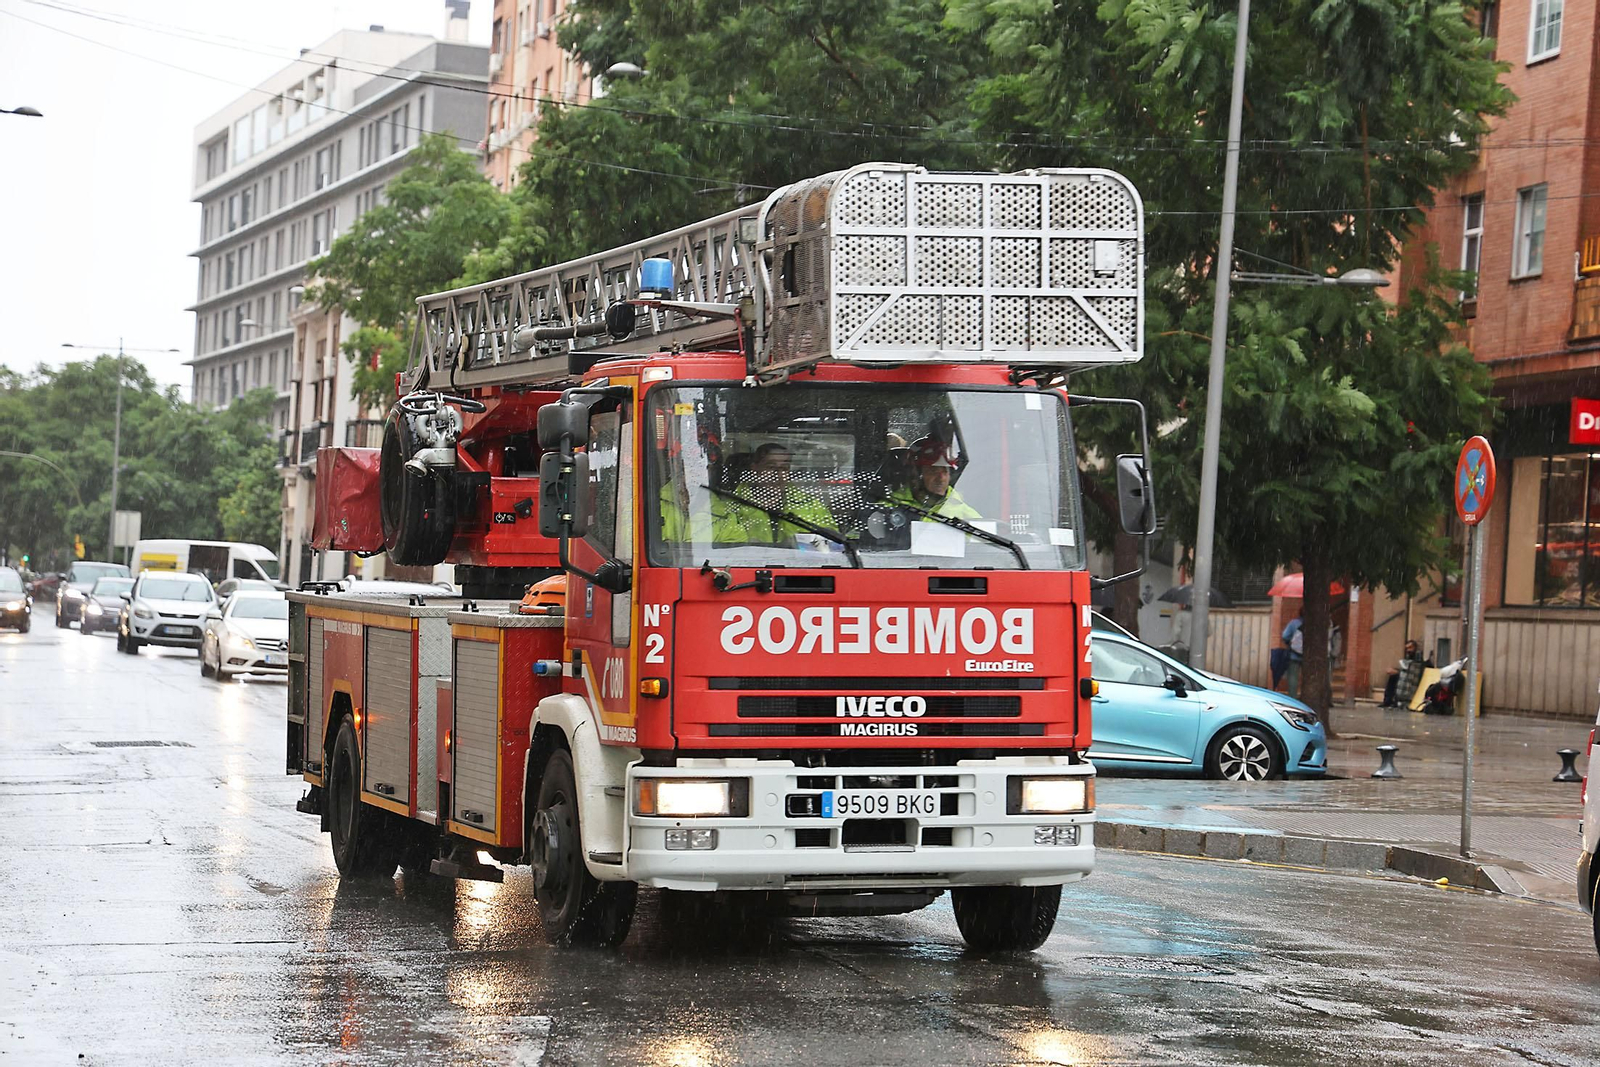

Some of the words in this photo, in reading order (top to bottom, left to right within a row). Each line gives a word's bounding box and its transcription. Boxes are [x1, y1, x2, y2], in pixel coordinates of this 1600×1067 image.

[645, 633, 664, 663] 2
[965, 660, 1034, 673] EuroFire
[610, 657, 624, 699] 080
[836, 696, 927, 717] IVECO
[608, 726, 637, 743] MAGIRUS
[840, 723, 918, 736] MAGIRUS
[837, 795, 889, 814] 9509
[896, 795, 935, 814] BKG
